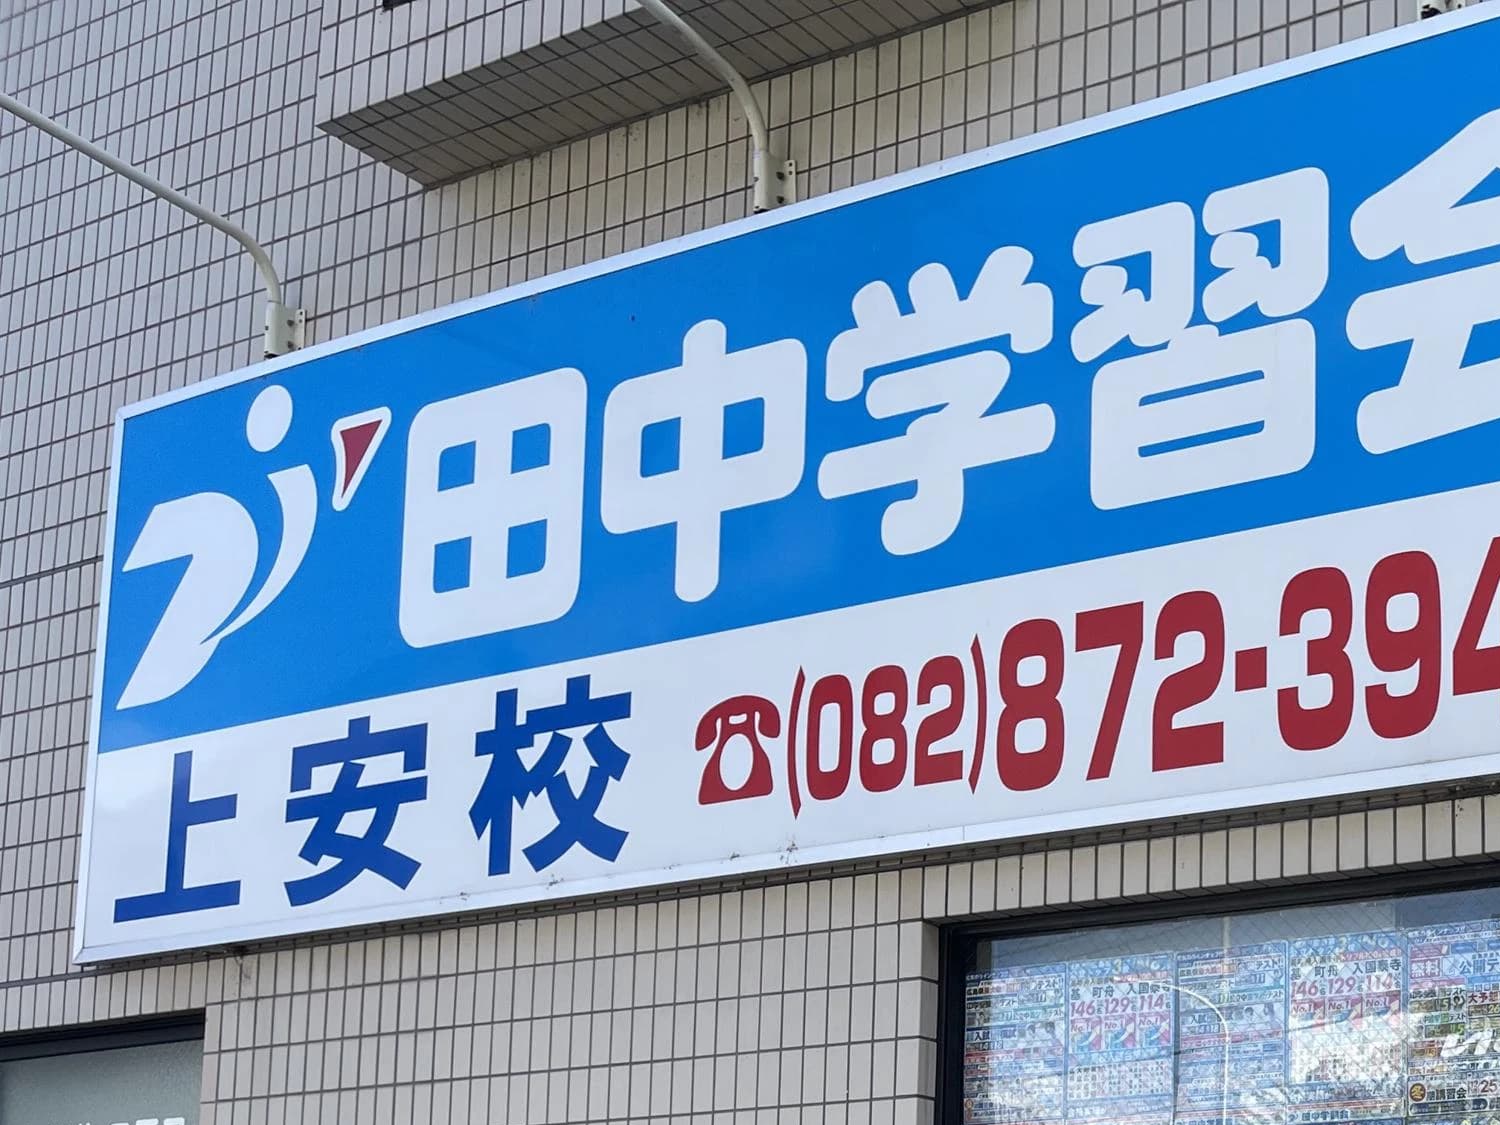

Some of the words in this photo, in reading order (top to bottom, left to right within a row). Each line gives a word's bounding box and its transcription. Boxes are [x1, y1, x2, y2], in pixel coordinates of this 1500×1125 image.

[114, 674, 632, 924] 上安校
[1328, 976, 1356, 995] 129
